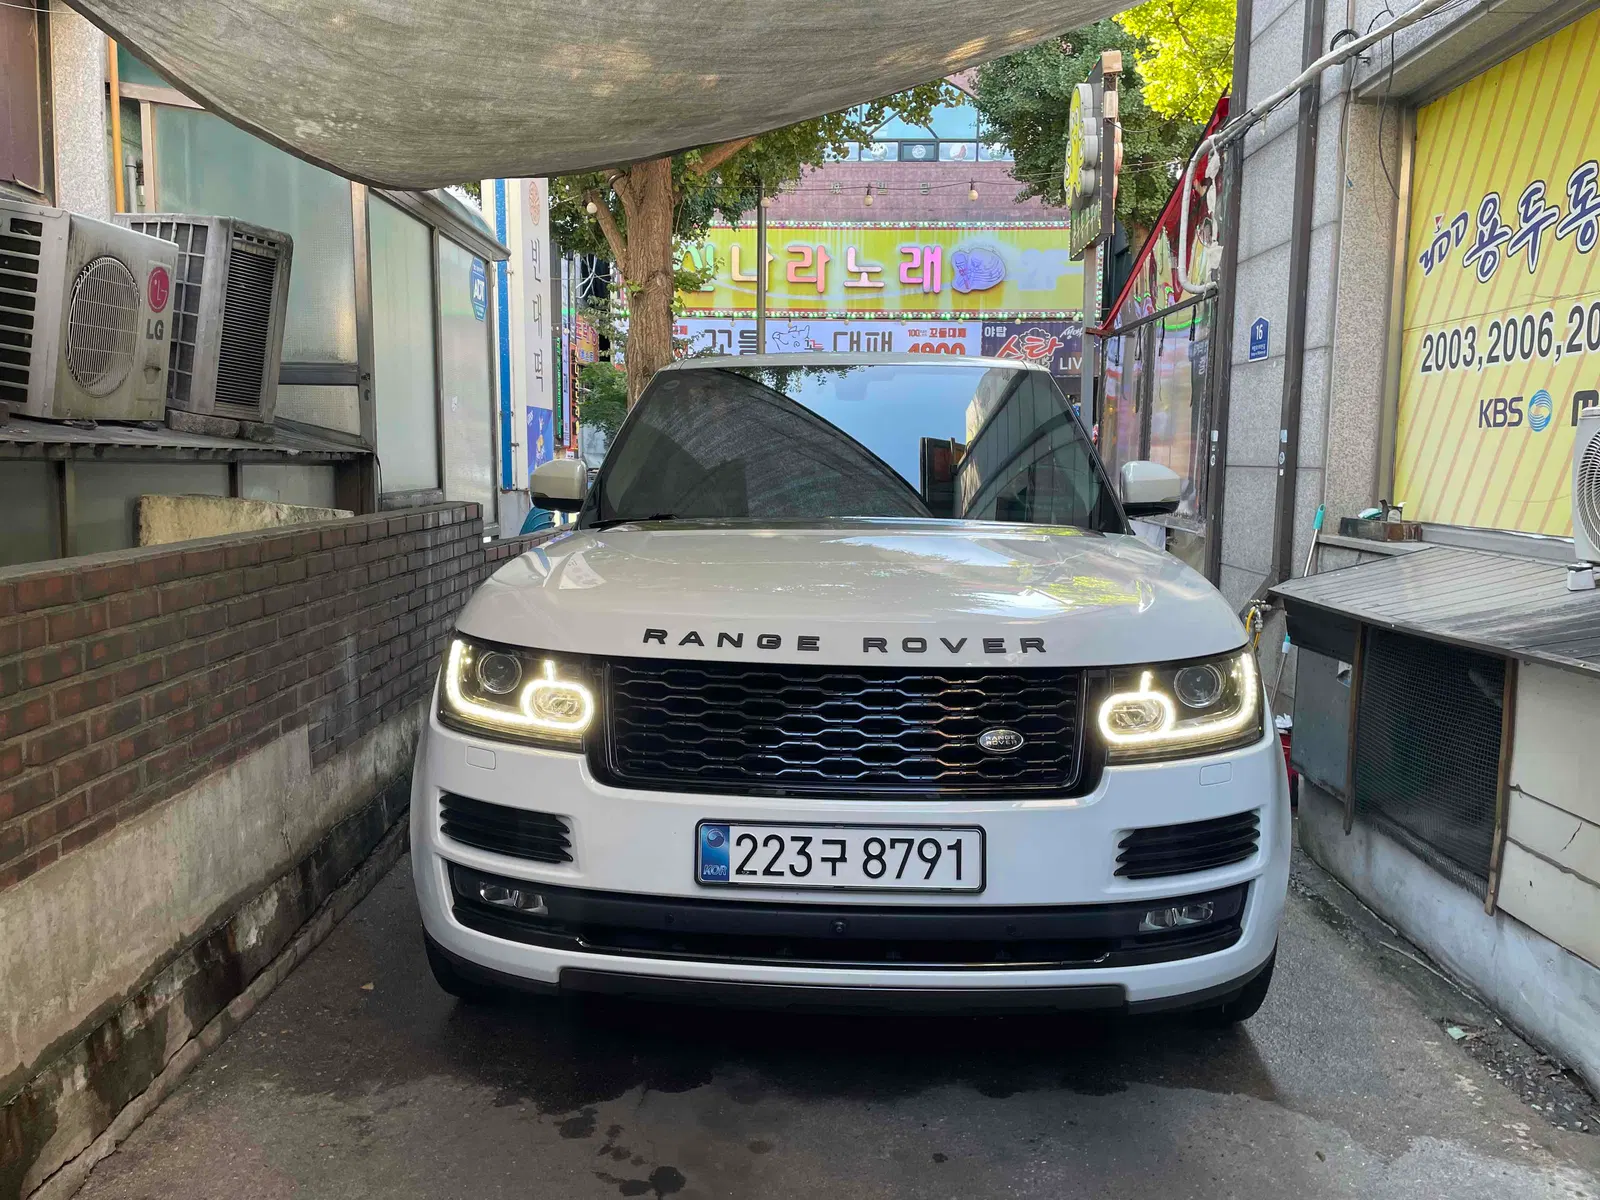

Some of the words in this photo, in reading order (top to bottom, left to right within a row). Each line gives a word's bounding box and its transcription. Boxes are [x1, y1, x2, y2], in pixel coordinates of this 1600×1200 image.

[146, 318, 164, 341] LG
[1256, 323, 1264, 340] 16
[1060, 357, 1084, 370] LIV
[1478, 396, 1523, 428] KBS
[642, 628, 821, 652] RANGE
[862, 636, 1047, 654] ROVER
[735, 833, 847, 877] 223구
[862, 837, 963, 880] 8791
[703, 864, 728, 876] KOR
